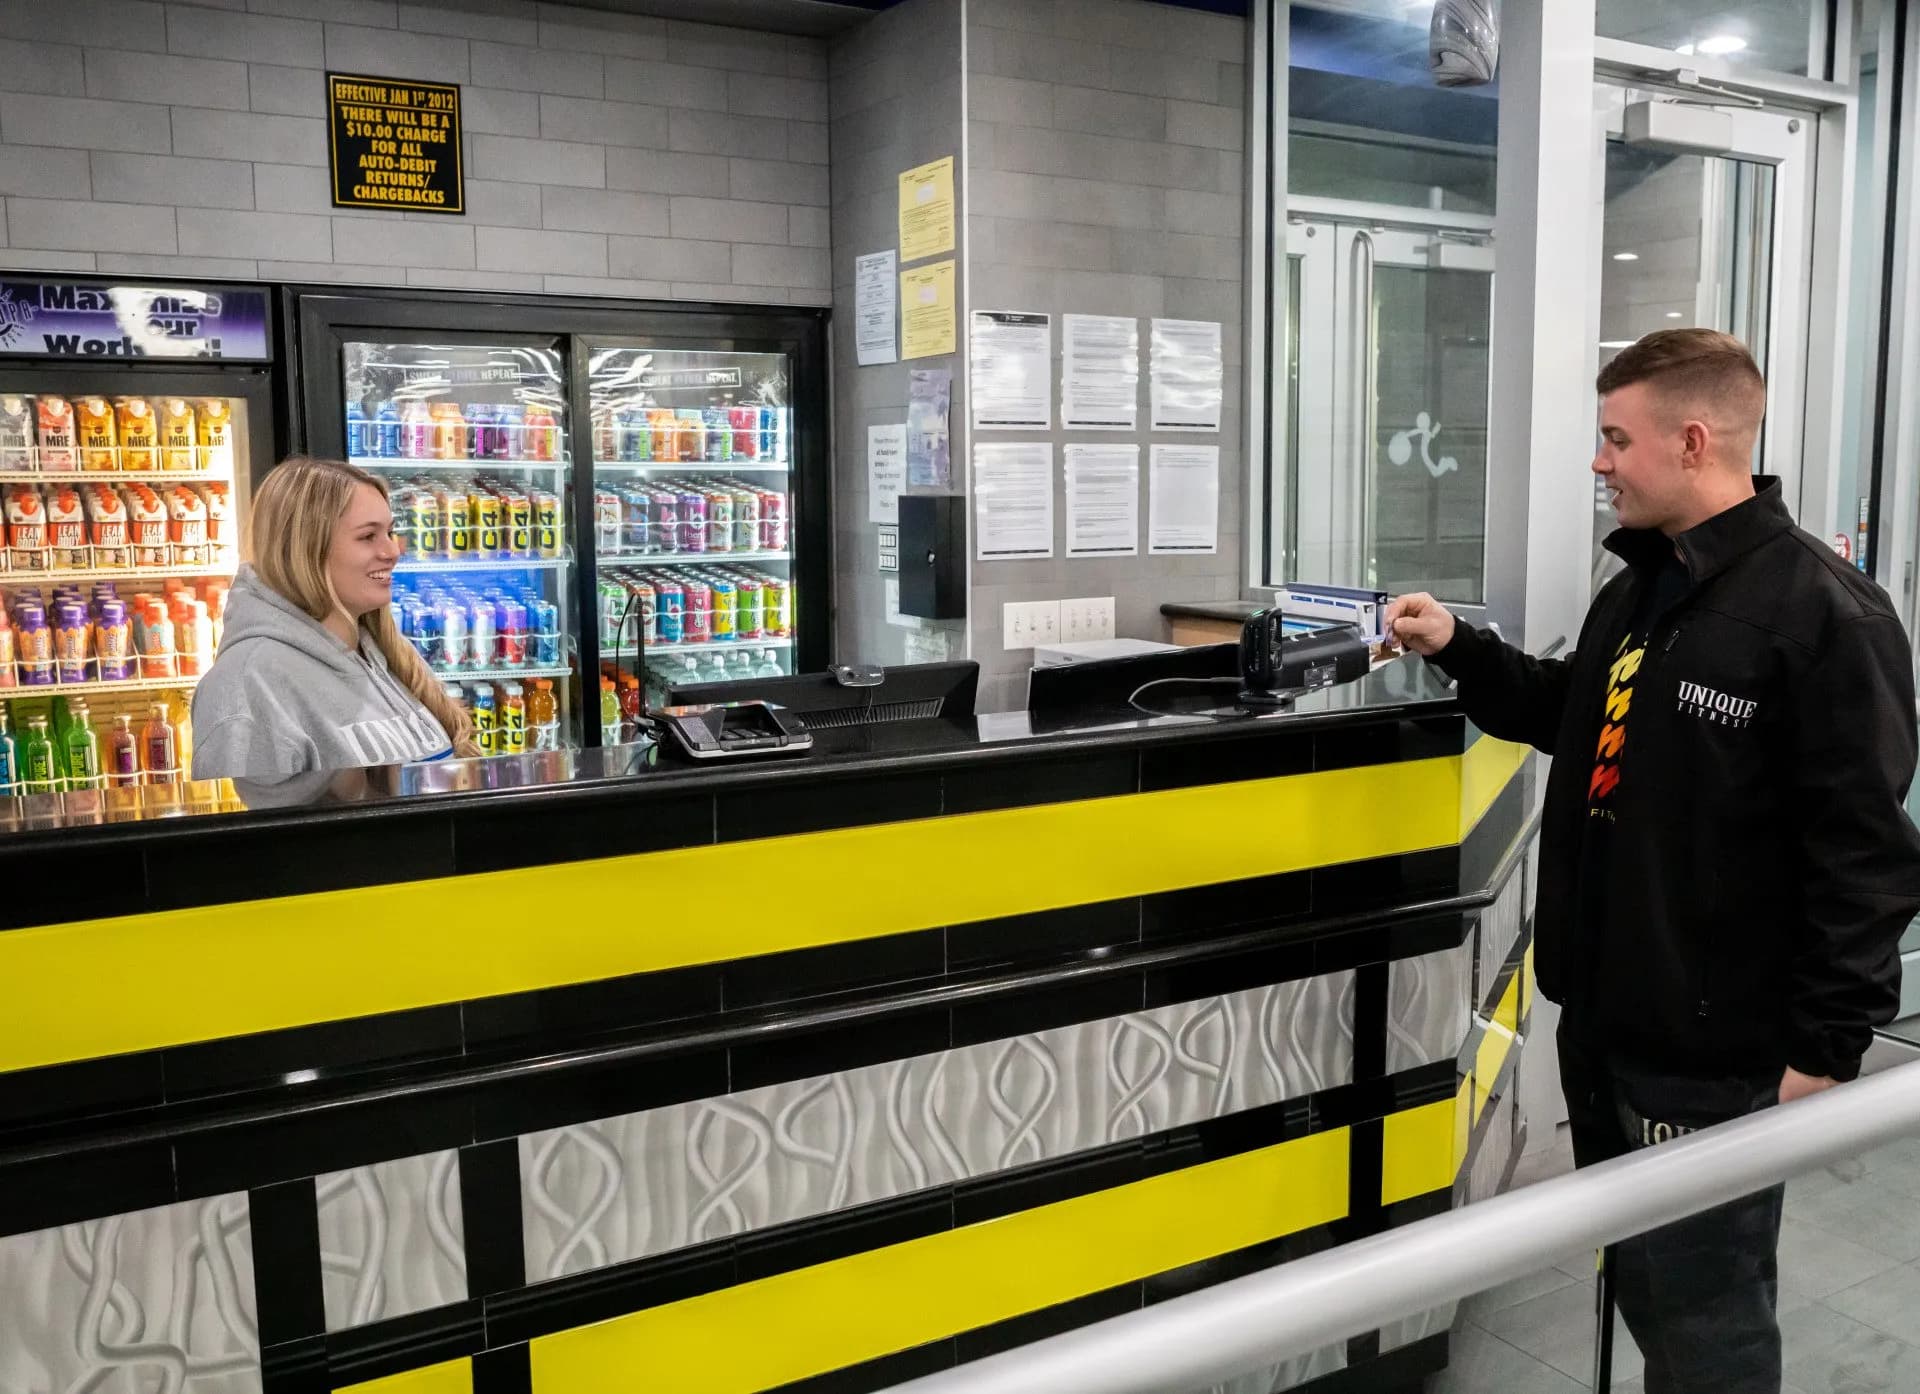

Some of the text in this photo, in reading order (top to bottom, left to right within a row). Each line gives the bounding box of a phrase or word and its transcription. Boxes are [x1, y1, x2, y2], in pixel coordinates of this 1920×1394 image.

[336, 84, 387, 103] EFFECTIVE
[390, 89, 409, 105] JAN
[428, 92, 454, 109] 2012
[341, 106, 450, 128] THERE WILL BE A
[346, 122, 446, 143] $10.00 CHARGE
[371, 141, 423, 156] FOR ALL
[359, 155, 437, 173] AUTO-DEBIT
[366, 171, 431, 188] RETURNS/
[353, 185, 445, 204] CHARGEBACKS
[46, 435, 70, 447] MRE
[88, 436, 111, 448] MRE
[128, 436, 150, 447] MRE
[169, 435, 190, 447] MRE
[17, 527, 42, 539] LEAN
[58, 524, 81, 537] LEAN
[421, 512, 437, 551] C4
[451, 512, 467, 551] C4
[482, 511, 498, 551] C4
[514, 511, 529, 550] C4
[539, 511, 555, 550] C4
[1678, 681, 1758, 719] UNIQUE
[479, 715, 492, 748] C4
[511, 713, 523, 748] C4
